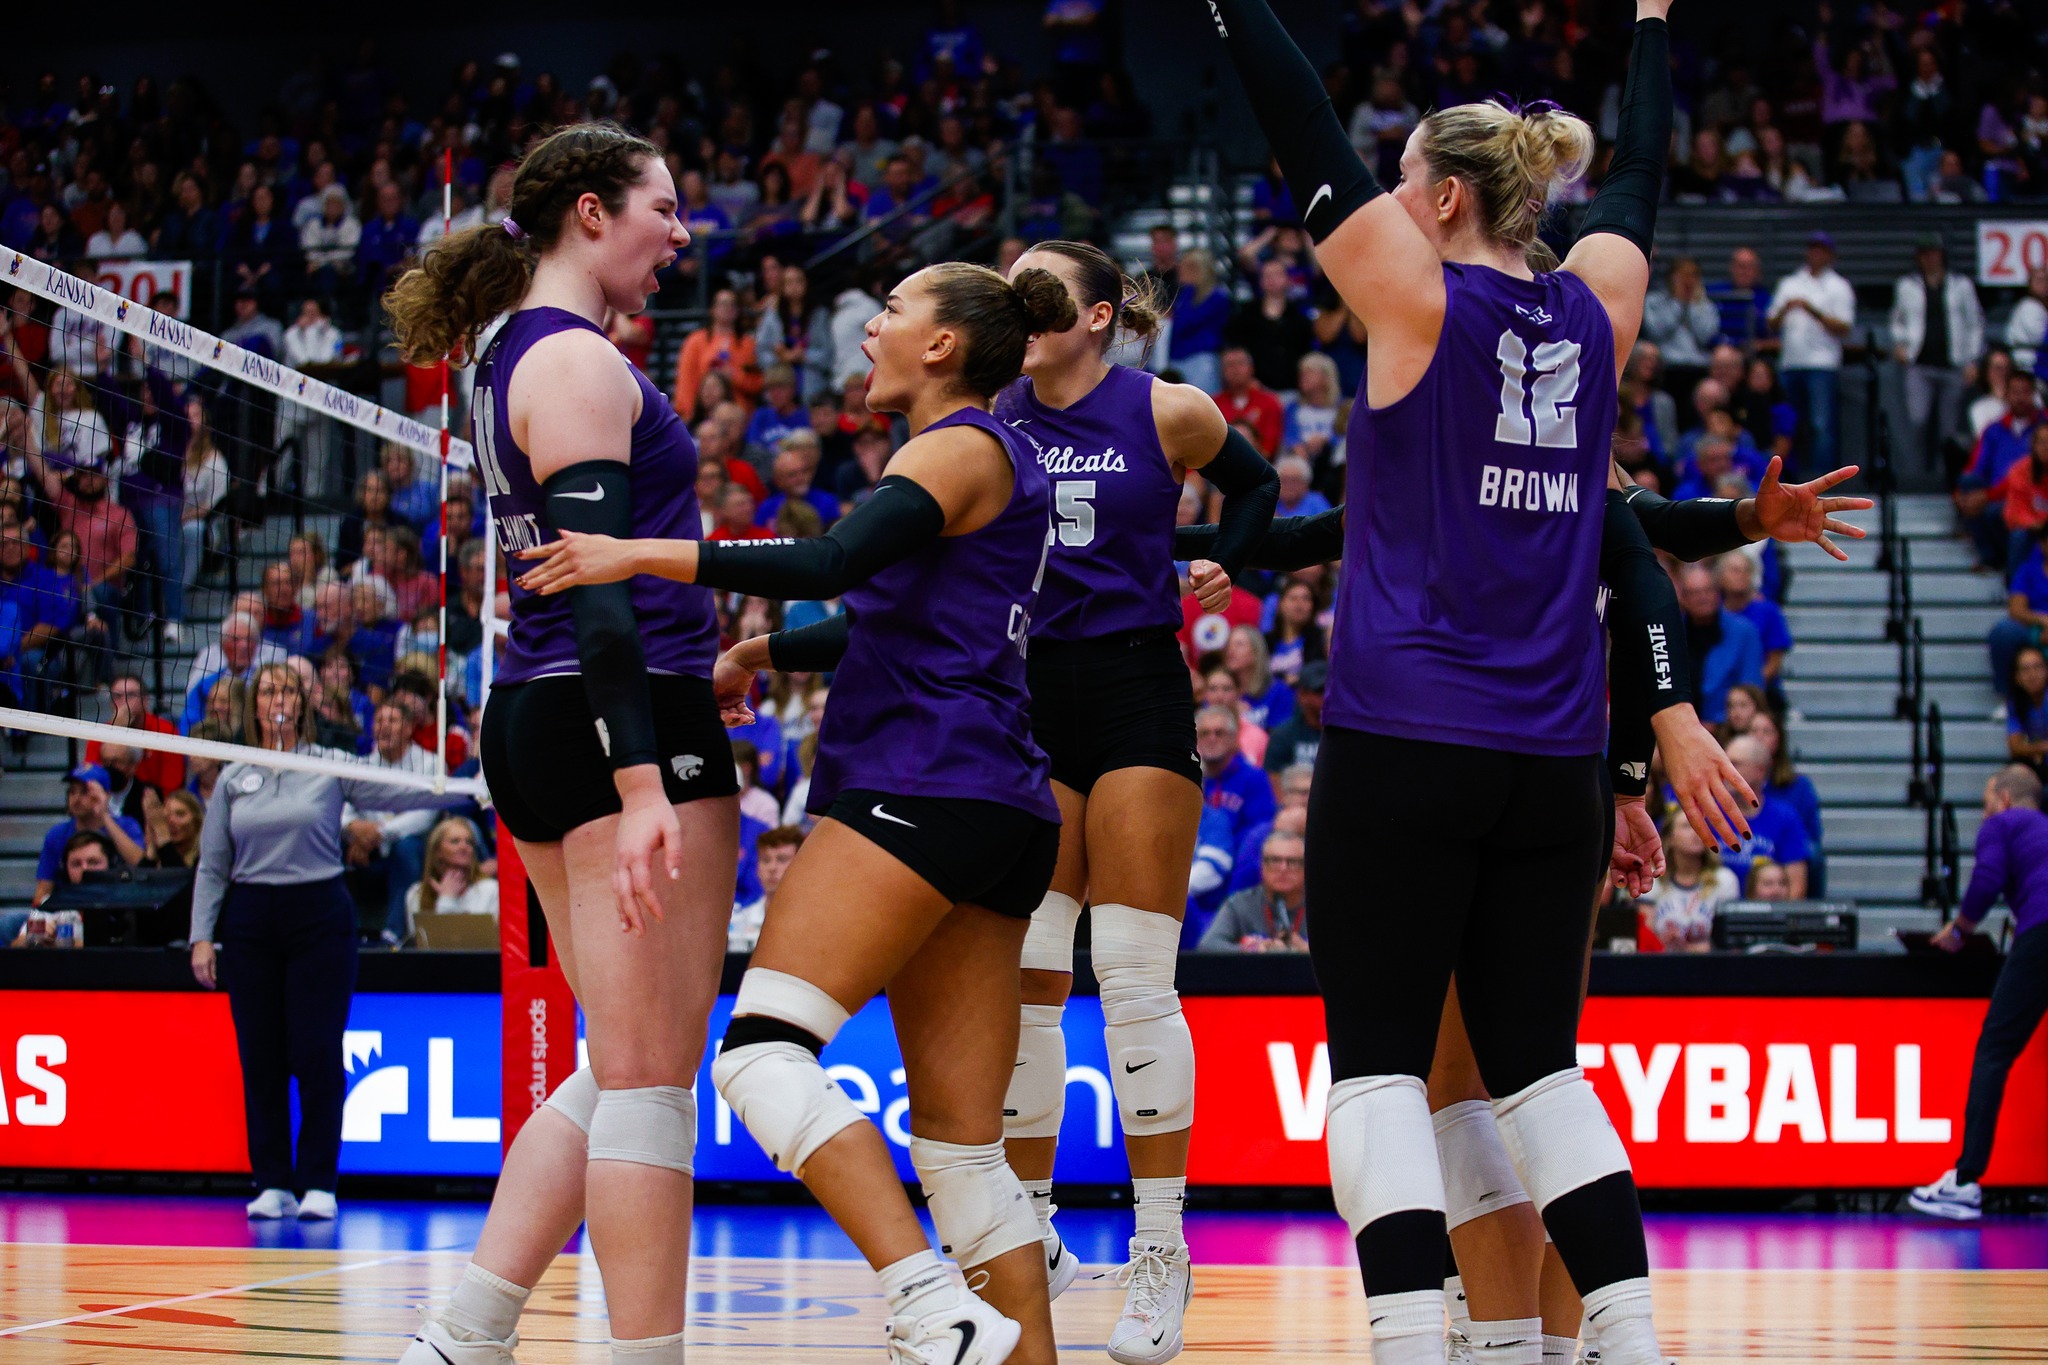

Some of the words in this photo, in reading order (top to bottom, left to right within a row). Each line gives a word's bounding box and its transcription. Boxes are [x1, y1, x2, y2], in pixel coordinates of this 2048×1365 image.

[46, 266, 95, 310] KANSAS
[150, 310, 193, 350] KANSAS
[241, 350, 281, 387] KANSAS
[1494, 328, 1581, 449] 12
[1036, 446, 1128, 474] ldcats
[1479, 464, 1579, 513] BROWN
[1048, 480, 1096, 547] 5
[719, 537, 796, 548] K-STATE
[1647, 623, 1673, 690] K-STATE
[528, 998, 549, 1060] sports
